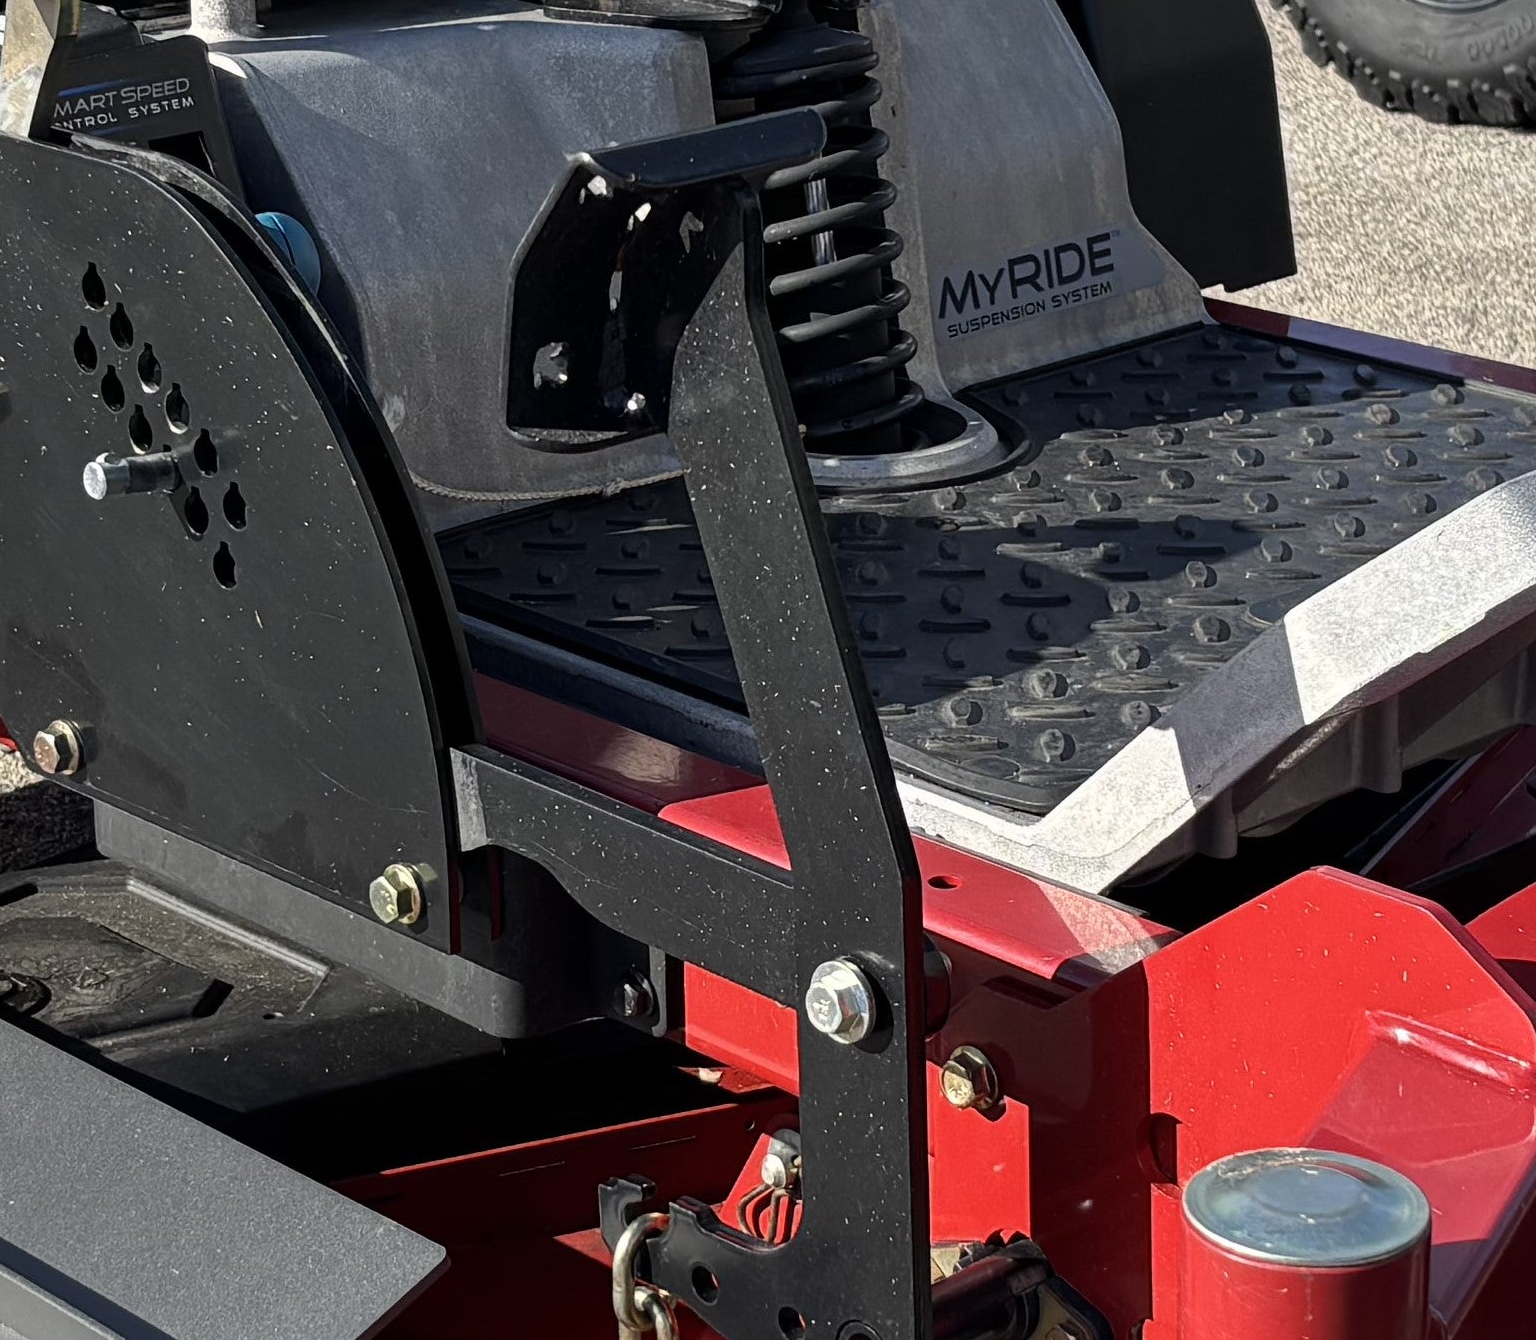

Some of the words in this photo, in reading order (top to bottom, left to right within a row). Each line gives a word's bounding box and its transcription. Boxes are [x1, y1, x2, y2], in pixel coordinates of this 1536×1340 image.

[53, 91, 118, 118] MART
[121, 77, 190, 104] SPEED
[53, 112, 118, 130] NTROL
[128, 96, 195, 119] SYSTEM
[947, 300, 1046, 338] SUSPENSION
[1050, 281, 1113, 309] SYSTEM
